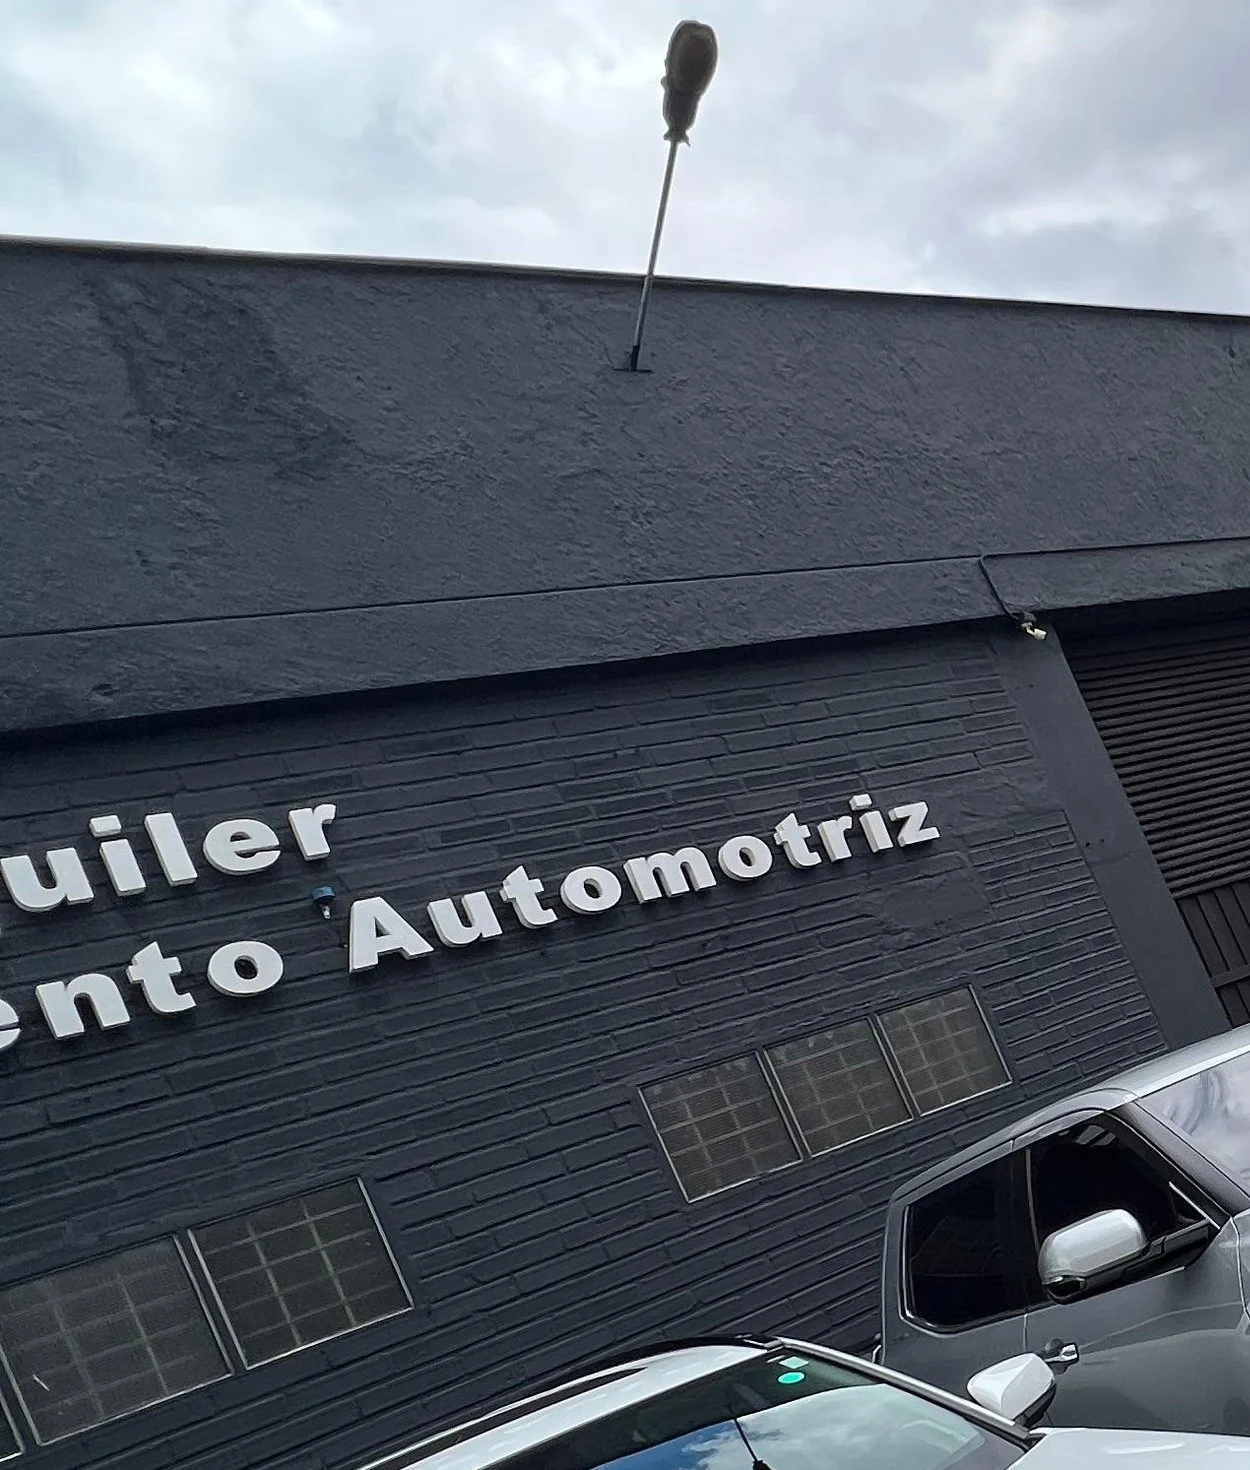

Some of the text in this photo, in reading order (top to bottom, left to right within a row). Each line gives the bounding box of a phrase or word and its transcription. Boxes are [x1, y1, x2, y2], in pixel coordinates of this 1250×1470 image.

[0, 802, 336, 912] uiler
[0, 793, 940, 1051] nto Automotriz
